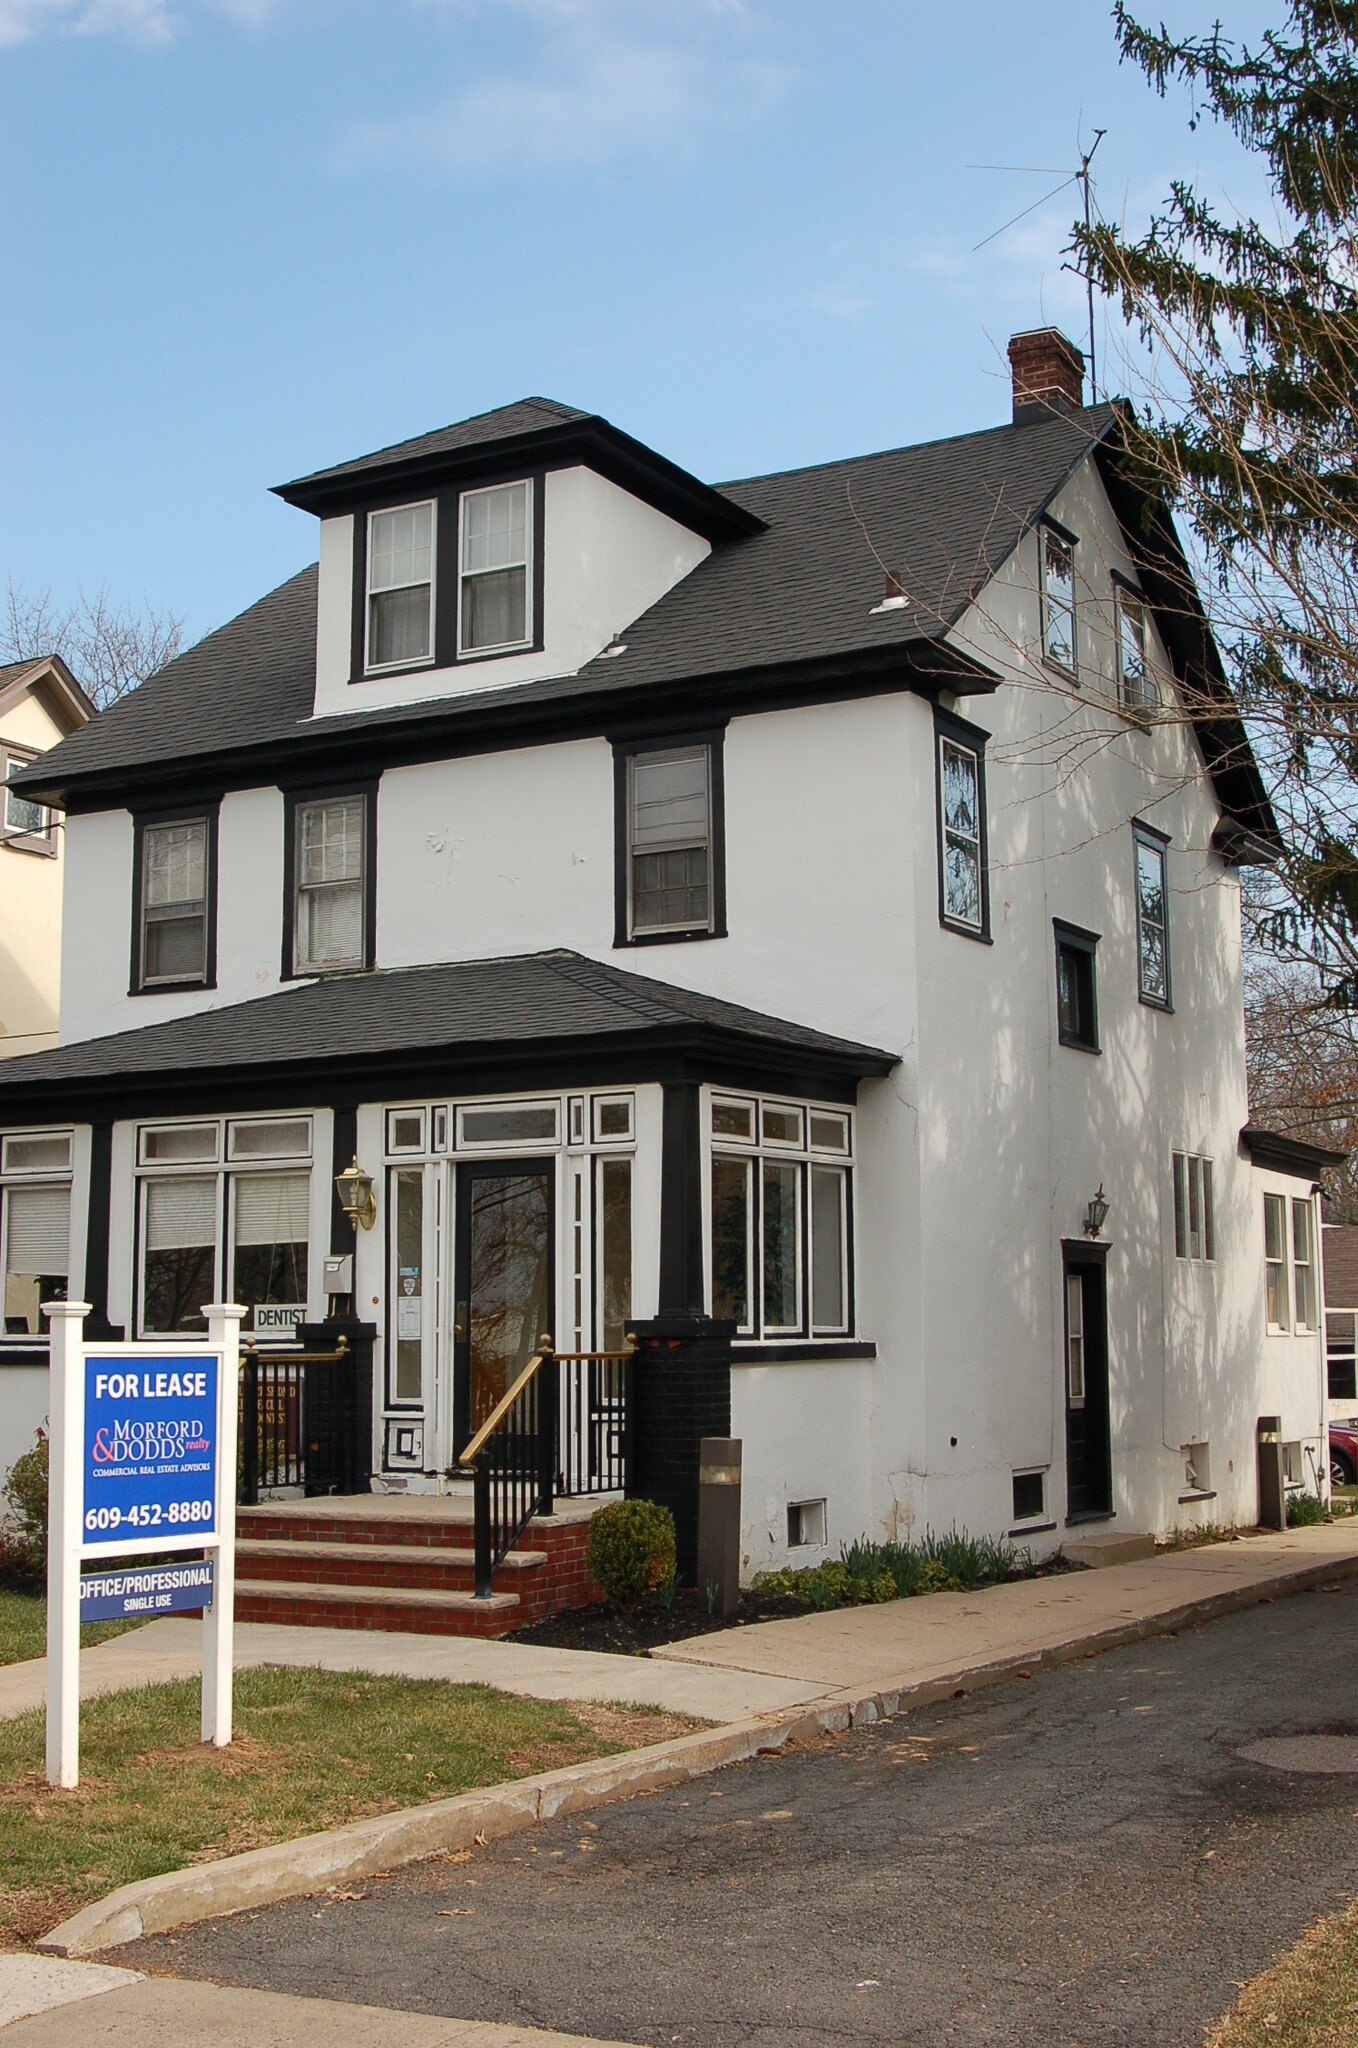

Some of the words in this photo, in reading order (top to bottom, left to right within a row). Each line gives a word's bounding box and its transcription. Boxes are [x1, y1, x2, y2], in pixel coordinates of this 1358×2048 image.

[258, 1309, 307, 1326] DENTIST
[95, 1374, 139, 1399] FOR
[143, 1373, 207, 1398] LEASE
[113, 1419, 203, 1441] MORFORD
[92, 1427, 115, 1463] &
[113, 1437, 185, 1462] DODDS
[185, 1437, 211, 1452] realty
[92, 1467, 139, 1478] COMMERCIAL
[140, 1465, 156, 1475] REAL
[157, 1464, 179, 1473] ESTATE
[180, 1462, 211, 1473] ADVISORS
[85, 1499, 213, 1530] 609-452-8880
[80, 1567, 213, 1599] OFFICE/PROFESSIONAL
[123, 1595, 155, 1612] SINGLE
[155, 1593, 172, 1608] USE
